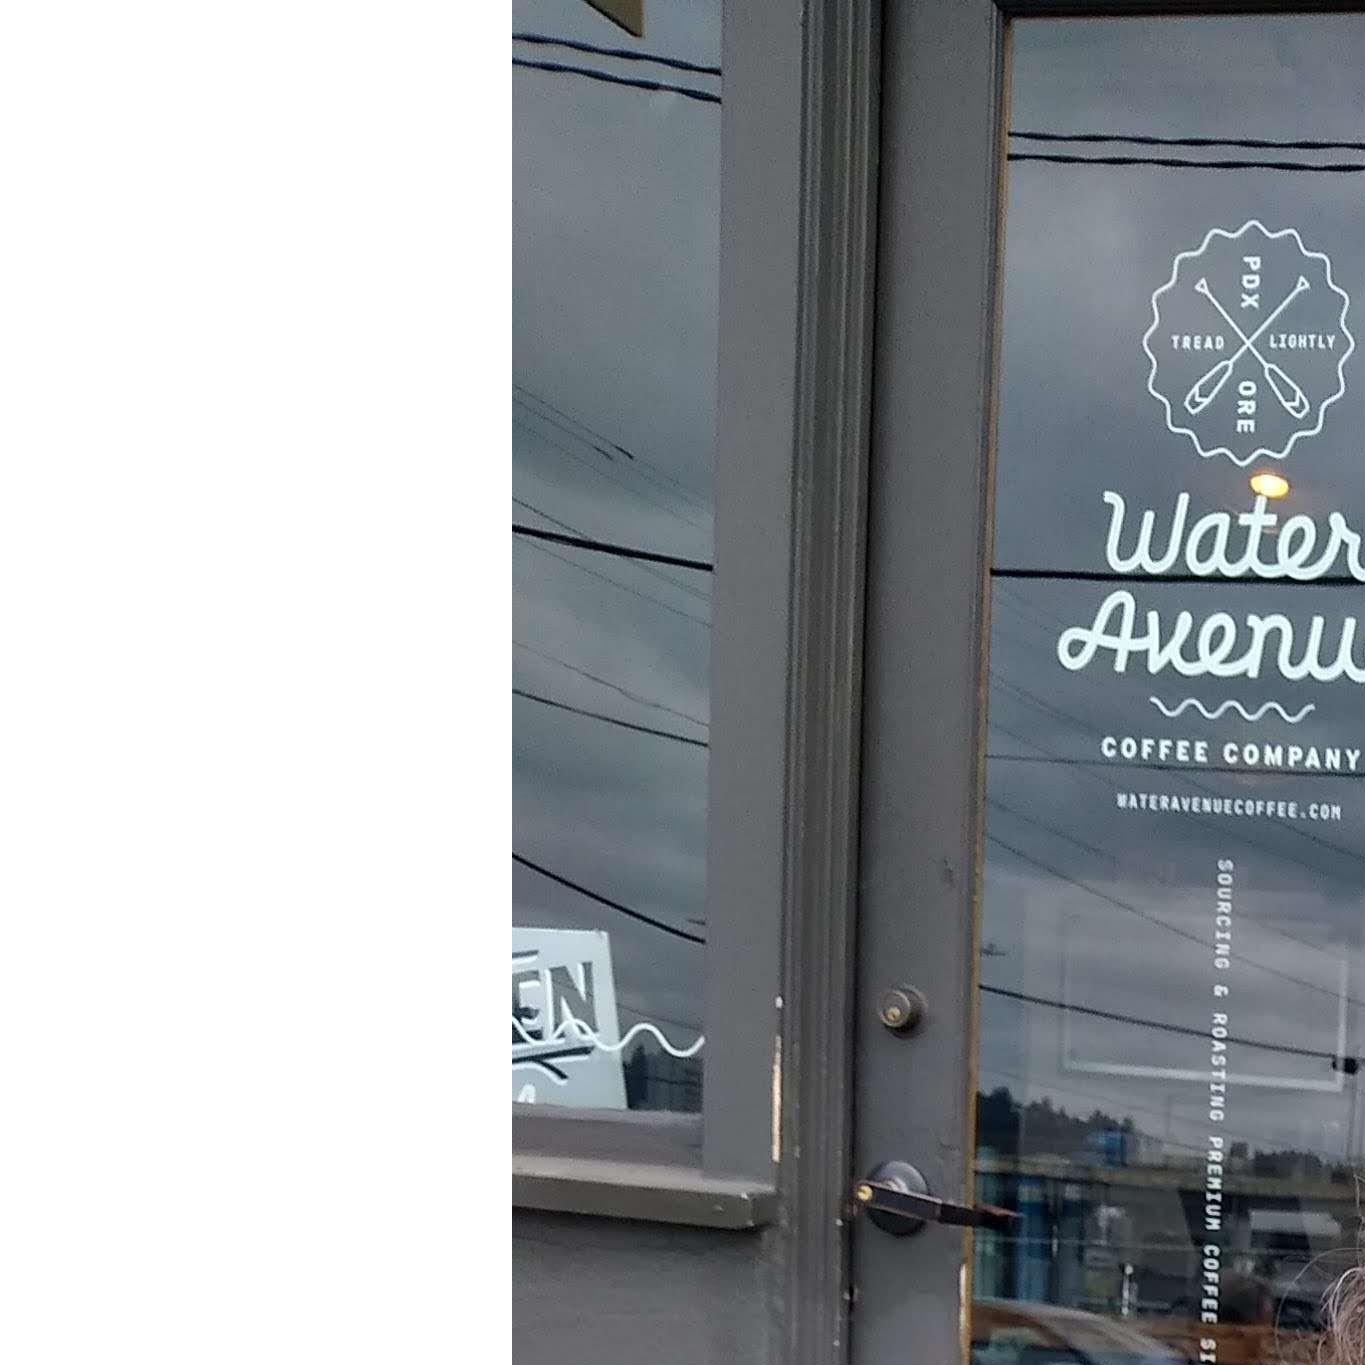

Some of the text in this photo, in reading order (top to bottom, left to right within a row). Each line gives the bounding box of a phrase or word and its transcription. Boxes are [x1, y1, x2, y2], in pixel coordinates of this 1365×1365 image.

[1241, 255, 1261, 310] PDX
[1171, 334, 1336, 351] TREAD LIGHTLY
[1236, 380, 1257, 434] ORE
[1101, 736, 1362, 770] COFFEE COMPANY
[1117, 793, 1341, 821] WATERAVENUECOFFEE.COM
[1213, 858, 1234, 969] SOURCING
[512, 961, 599, 1042] EN
[1209, 1012, 1229, 1122] ROASTING
[1204, 1136, 1224, 1231] PREMIUM
[1201, 1244, 1221, 1325] COFFEE
